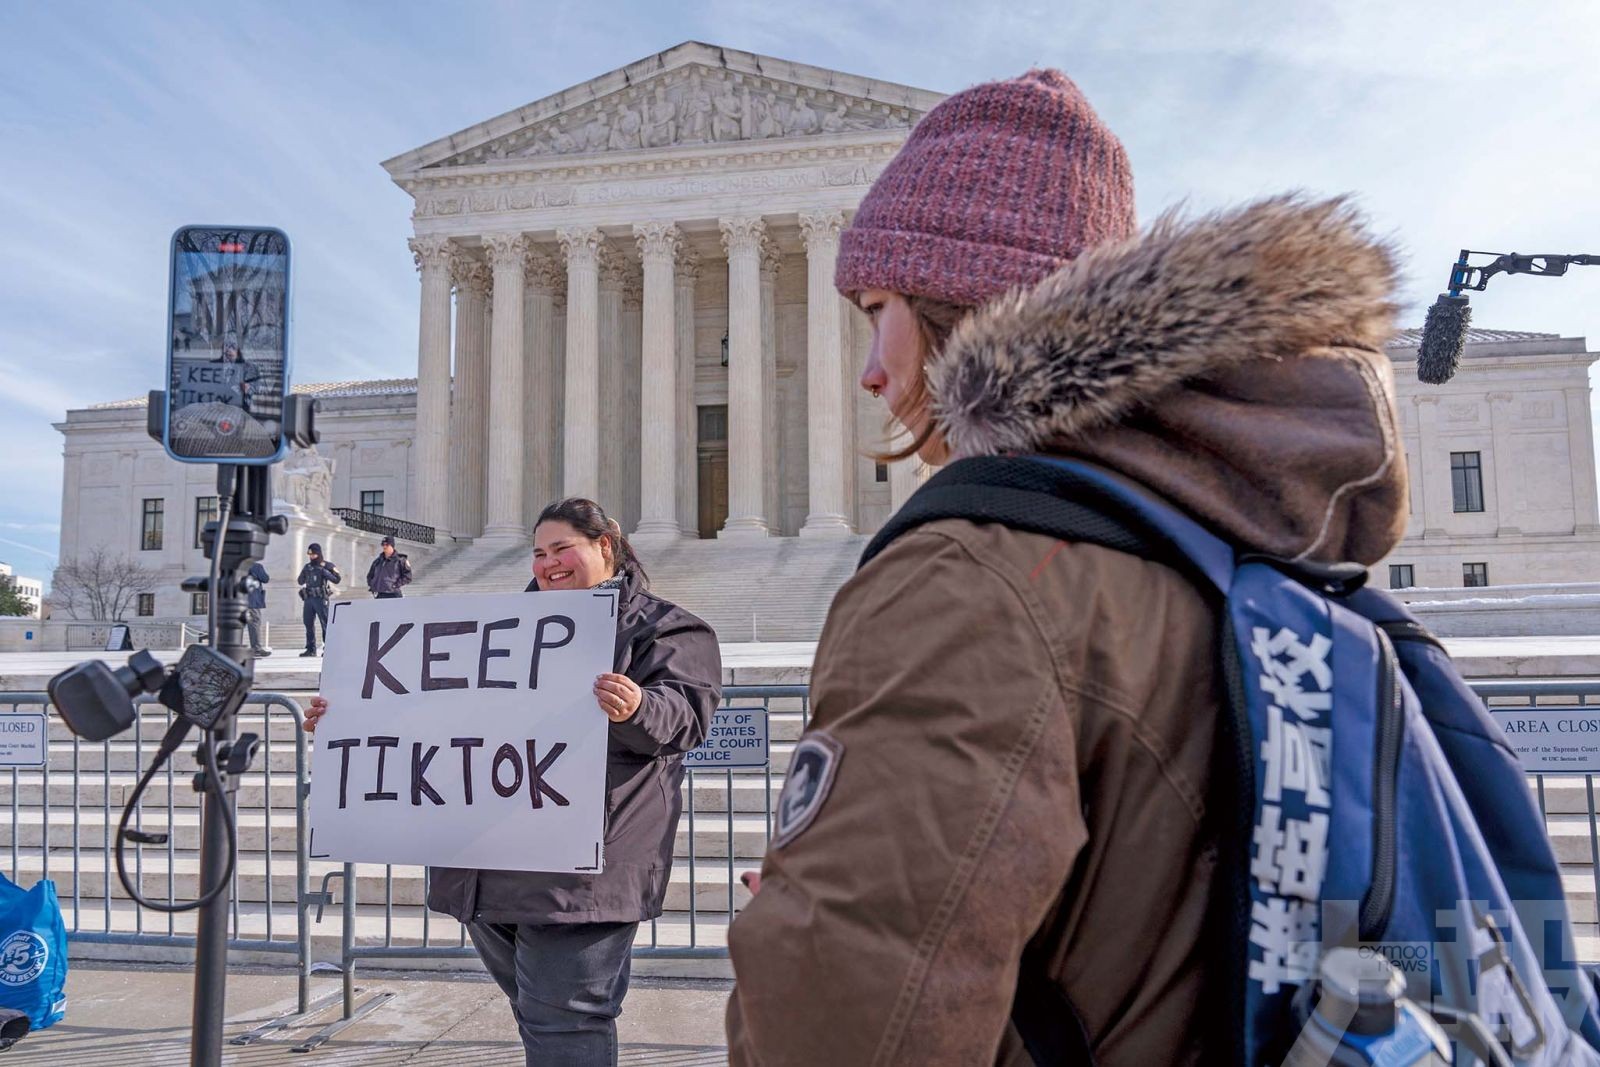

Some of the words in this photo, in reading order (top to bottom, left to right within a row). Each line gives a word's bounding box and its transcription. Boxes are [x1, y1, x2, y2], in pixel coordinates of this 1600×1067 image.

[588, 185, 641, 202] EQUAL
[647, 180, 714, 197] JUSTICE
[717, 176, 769, 192] UNDER
[775, 174, 809, 189] LAW
[188, 366, 235, 384] KEEP
[361, 614, 576, 699] KEEP
[711, 715, 729, 724] TY
[735, 714, 752, 724] OF
[711, 726, 756, 736] STATES
[1505, 720, 1550, 733] AREA
[1557, 719, 1600, 733] CLOS
[719, 738, 763, 748] COURT
[686, 751, 731, 761] POLICE
[1552, 746, 1579, 754] Supreme
[327, 736, 570, 809] TIKTOK
